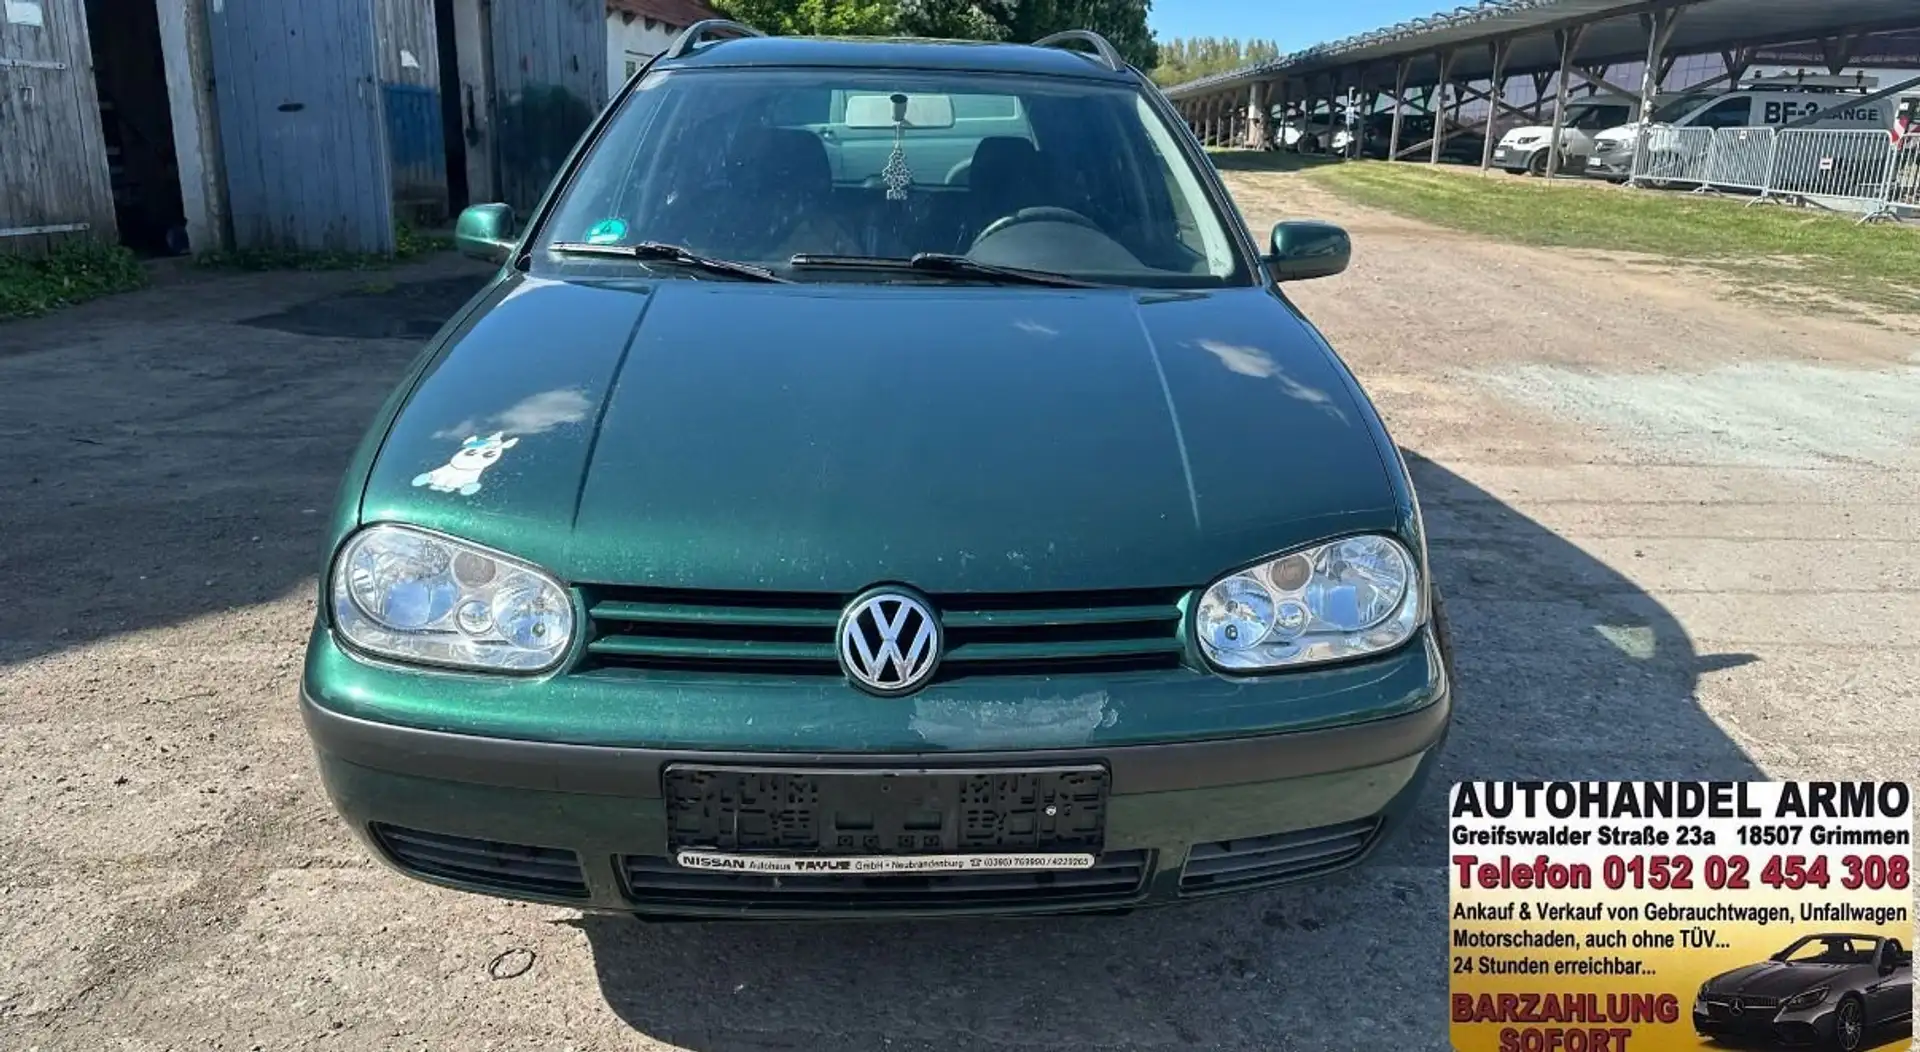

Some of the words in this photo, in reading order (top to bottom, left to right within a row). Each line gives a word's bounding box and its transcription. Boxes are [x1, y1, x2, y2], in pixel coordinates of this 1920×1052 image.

[843, 594, 937, 688] VW
[683, 855, 745, 869] NISSAN
[855, 861, 883, 870] GmbH
